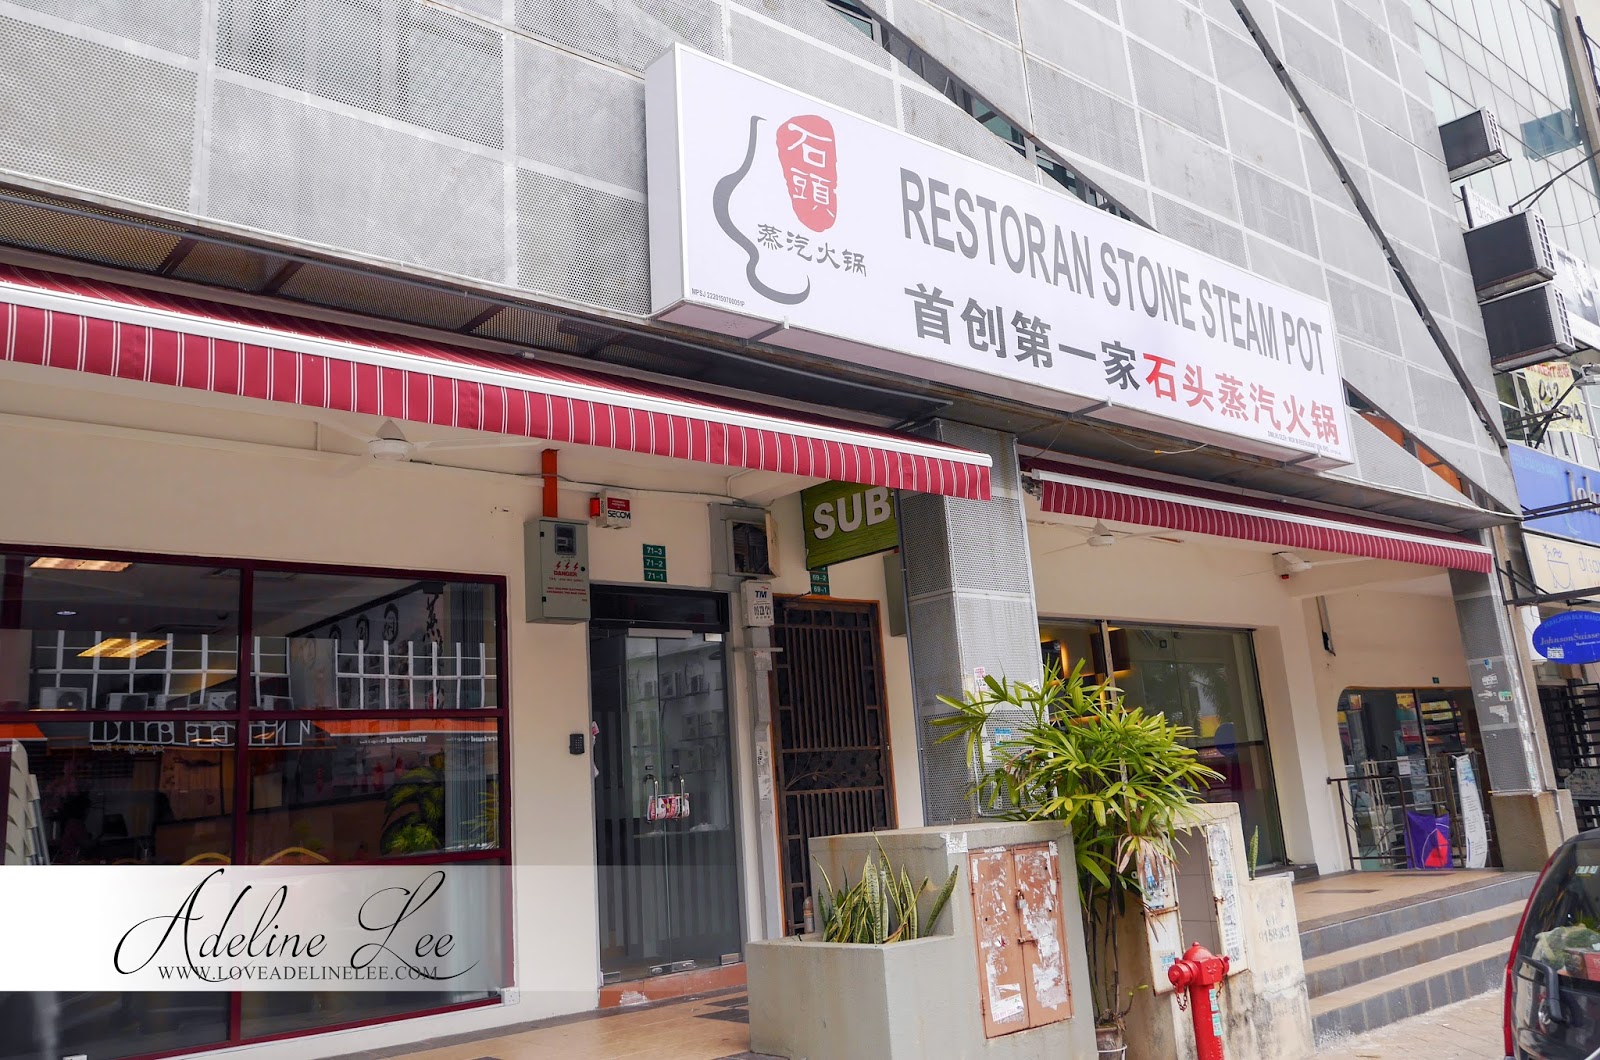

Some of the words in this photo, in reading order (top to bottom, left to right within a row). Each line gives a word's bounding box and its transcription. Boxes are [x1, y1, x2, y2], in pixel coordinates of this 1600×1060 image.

[757, 223, 867, 278] 蒸汽火锅
[900, 167, 1094, 298] RESTORAN
[1100, 242, 1196, 332] STONE
[1198, 278, 1280, 361] STEAM
[1282, 311, 1326, 375] POT
[607, 510, 631, 520] SECOM
[813, 486, 897, 540] SUB
[646, 546, 663, 555] 71-3
[646, 559, 663, 568] 71-2
[647, 572, 664, 580] 71-1
[755, 590, 768, 599] TM
